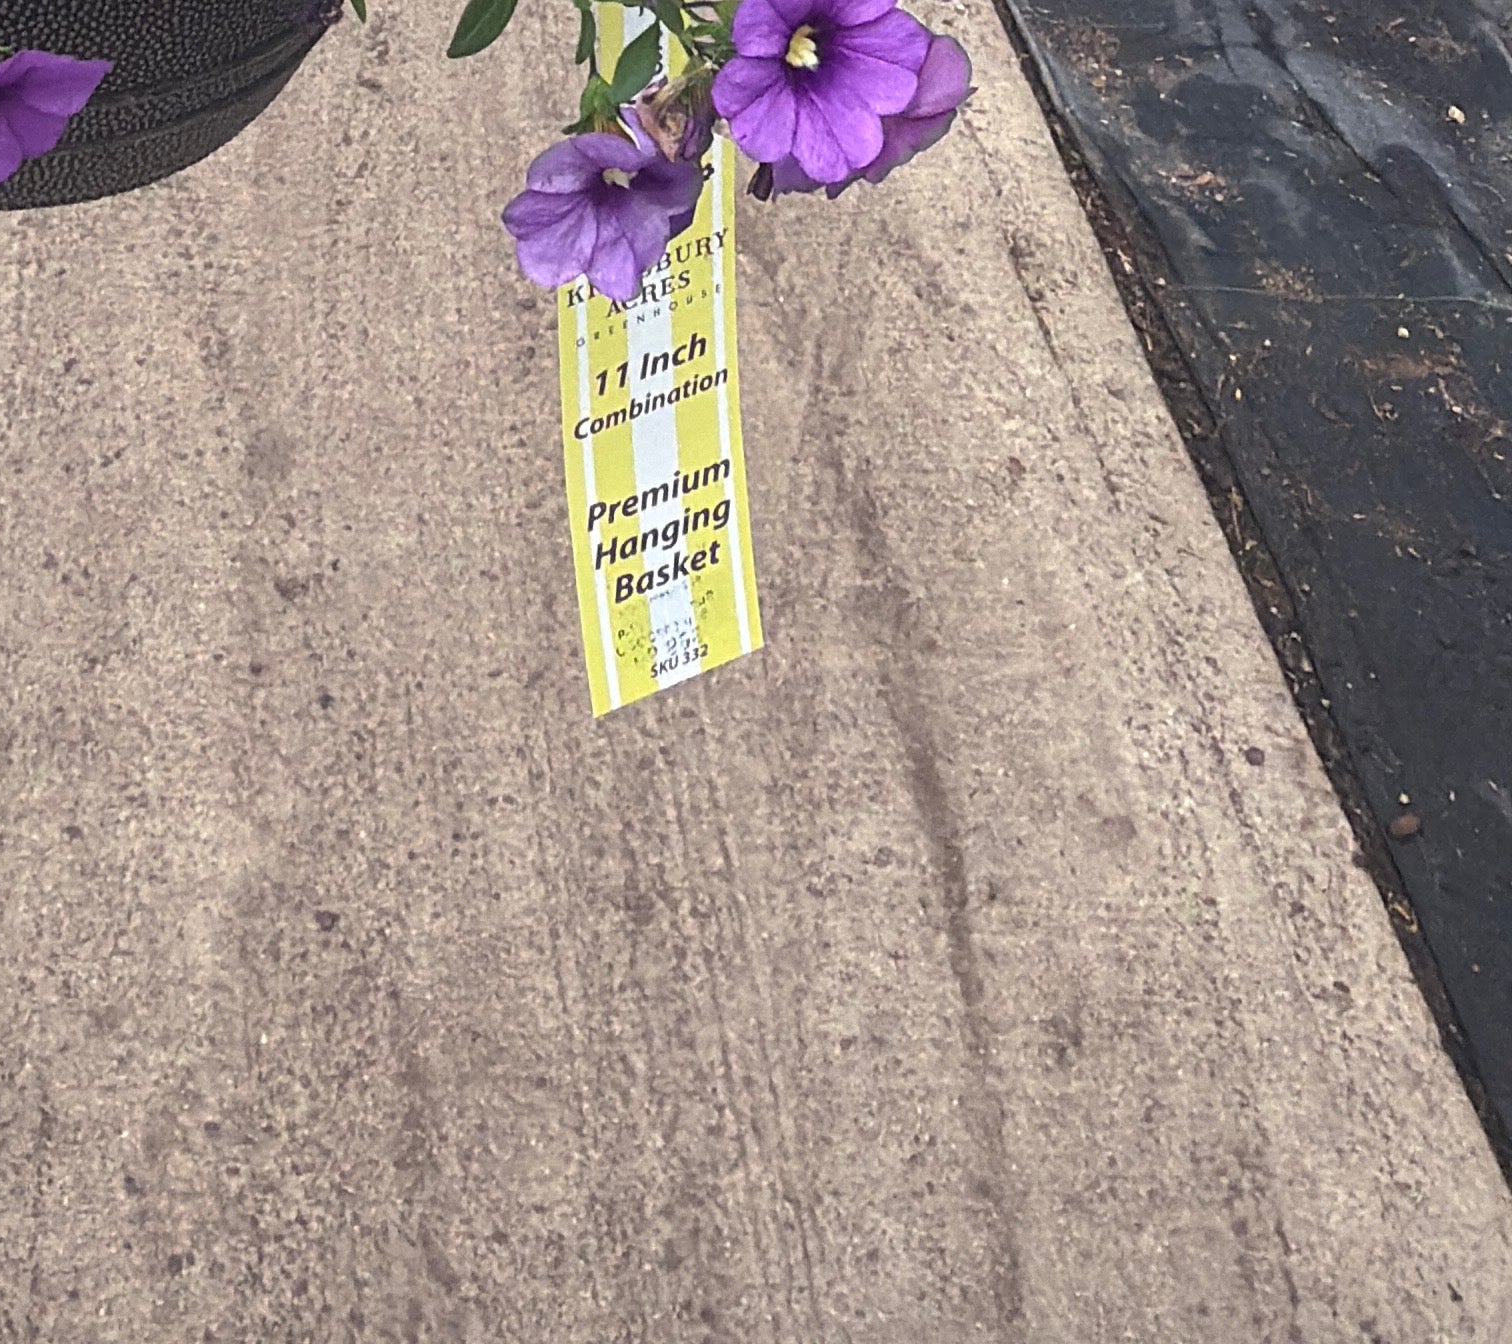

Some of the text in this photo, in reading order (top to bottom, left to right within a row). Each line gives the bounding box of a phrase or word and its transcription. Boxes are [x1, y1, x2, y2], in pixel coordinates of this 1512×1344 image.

[595, 332, 707, 396] 11 Inch
[574, 367, 728, 440] Combination
[587, 458, 730, 533] Premium
[594, 498, 731, 571] Hanging
[615, 540, 721, 604] Basket
[650, 643, 709, 679] SKU 332
